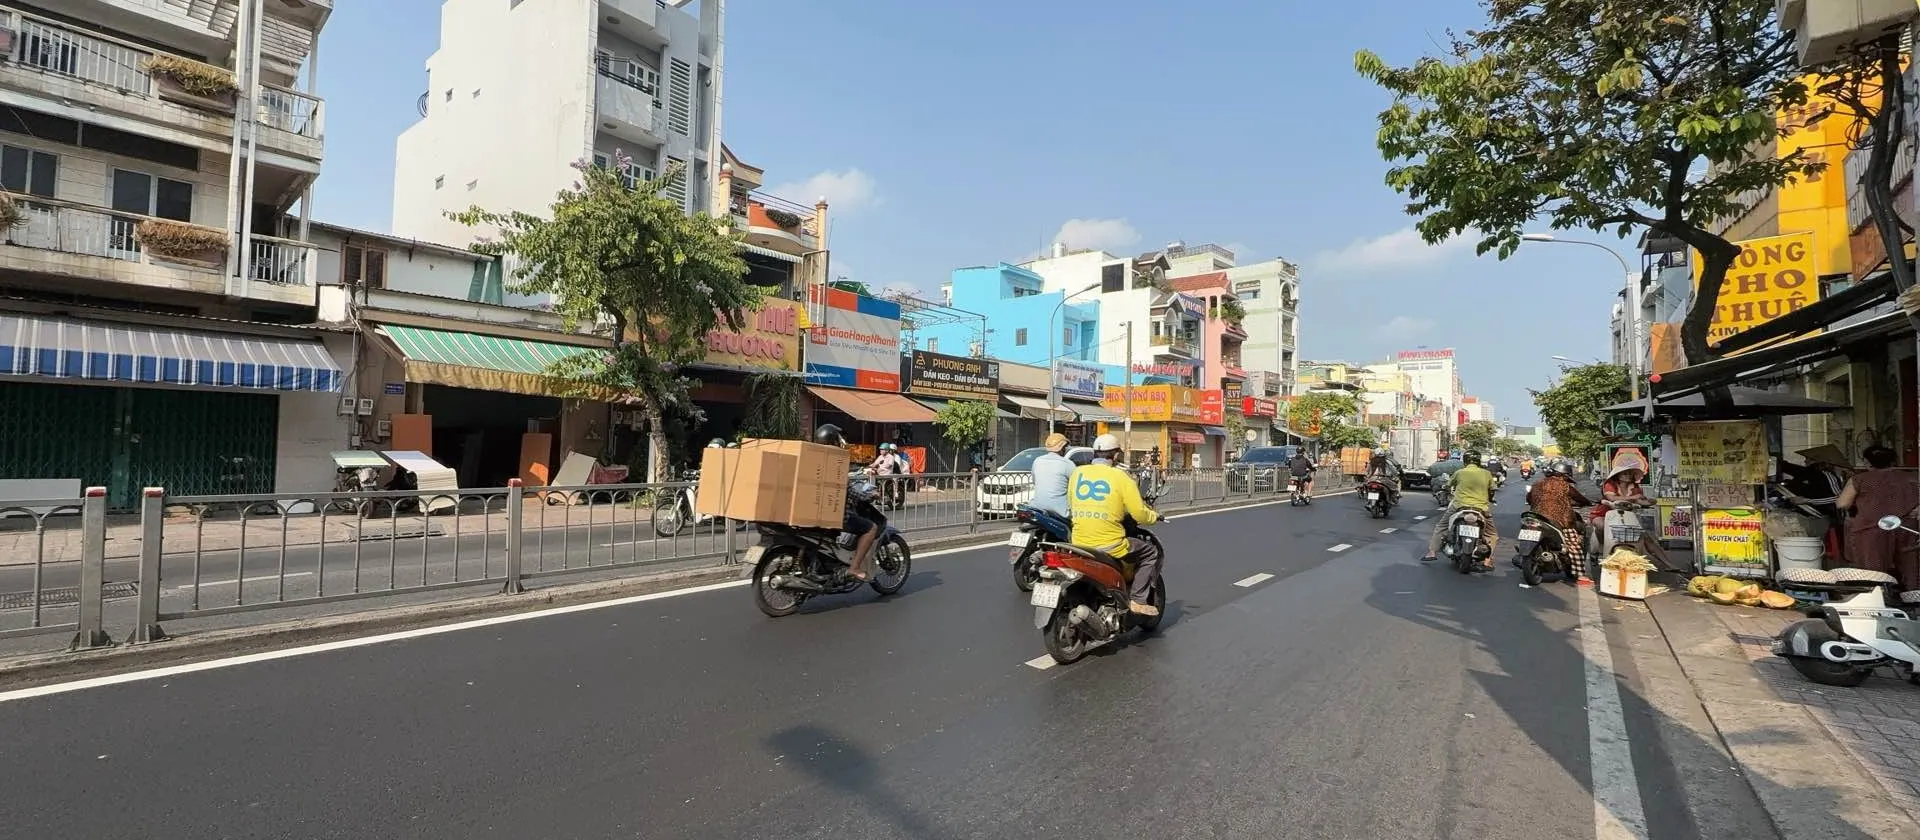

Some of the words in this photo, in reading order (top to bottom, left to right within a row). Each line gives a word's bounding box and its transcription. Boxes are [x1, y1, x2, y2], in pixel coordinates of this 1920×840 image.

[1728, 242, 1805, 270] ÒNG
[923, 369, 937, 379] DÁN
[965, 363, 981, 373] ANH
[1076, 472, 1111, 501] be
